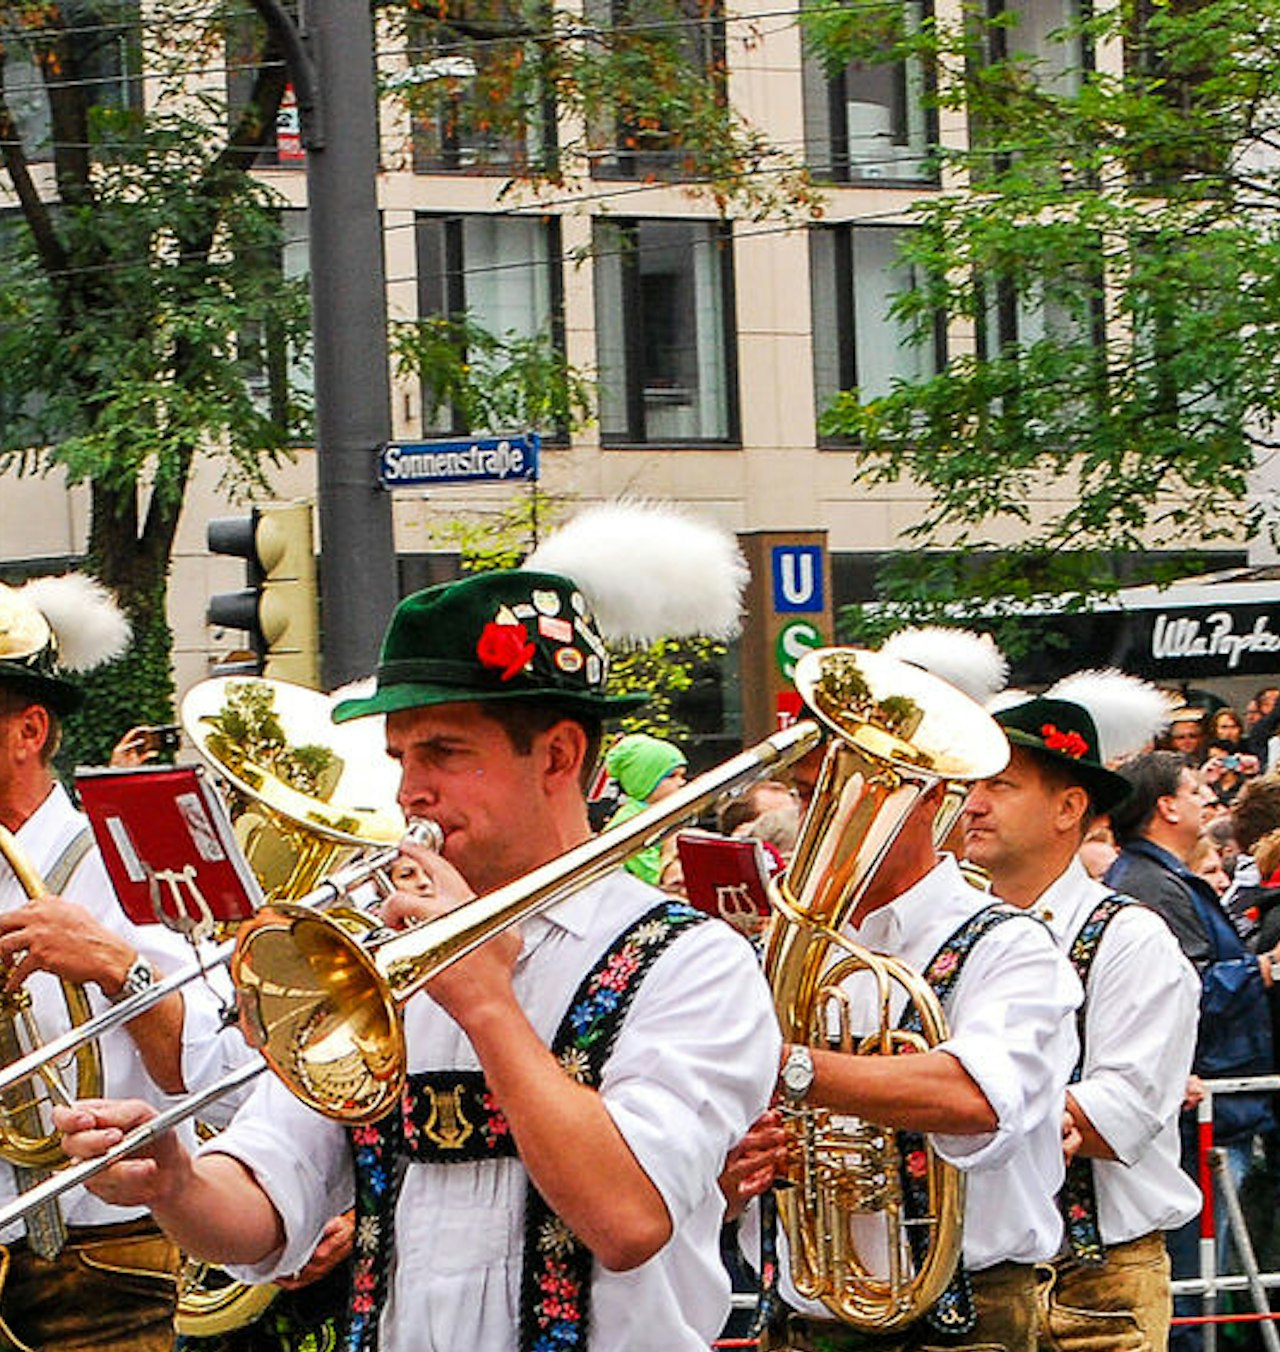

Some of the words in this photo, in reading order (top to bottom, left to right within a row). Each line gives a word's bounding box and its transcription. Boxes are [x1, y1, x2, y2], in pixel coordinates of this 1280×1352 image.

[384, 440, 524, 479] Sonnenstraße
[780, 553, 813, 604] U
[783, 624, 817, 679] S
[1152, 614, 1208, 659] Ulla
